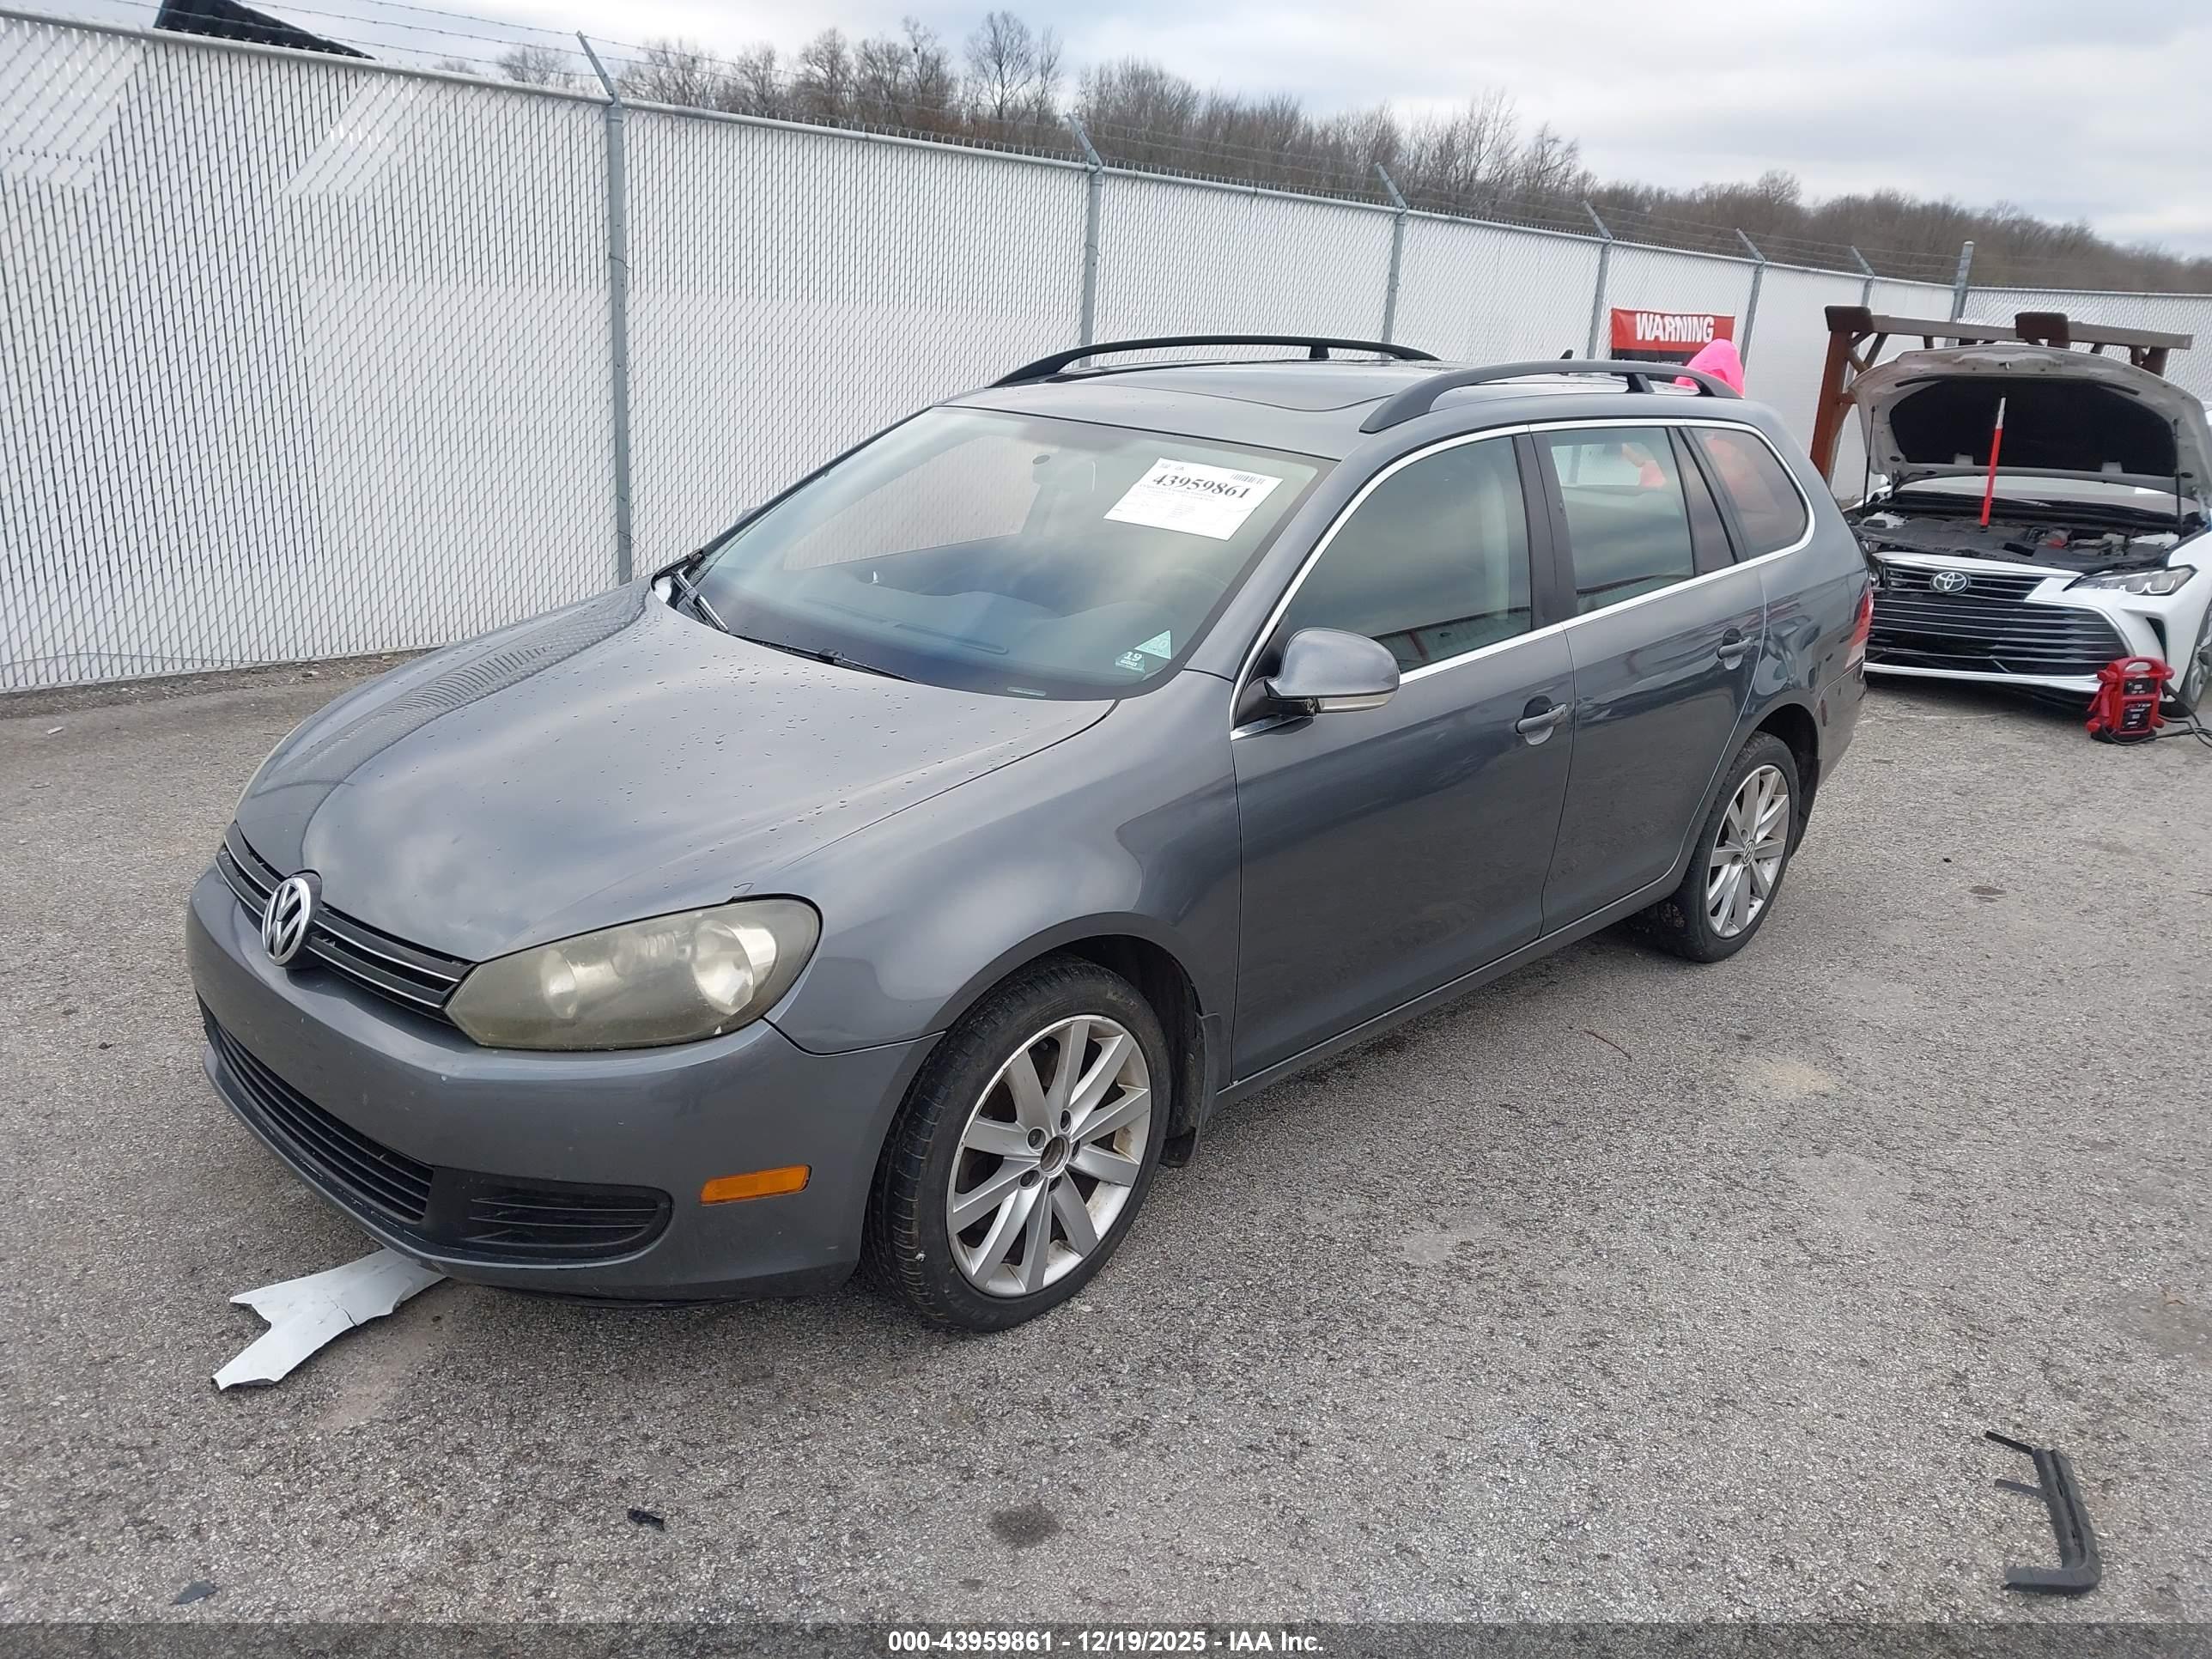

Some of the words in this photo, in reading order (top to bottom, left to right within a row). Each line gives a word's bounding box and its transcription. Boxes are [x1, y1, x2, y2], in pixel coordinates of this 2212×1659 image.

[1636, 313, 1715, 342] WARNING
[1153, 474, 1250, 498] 43959861
[1124, 652, 1142, 661] 19
